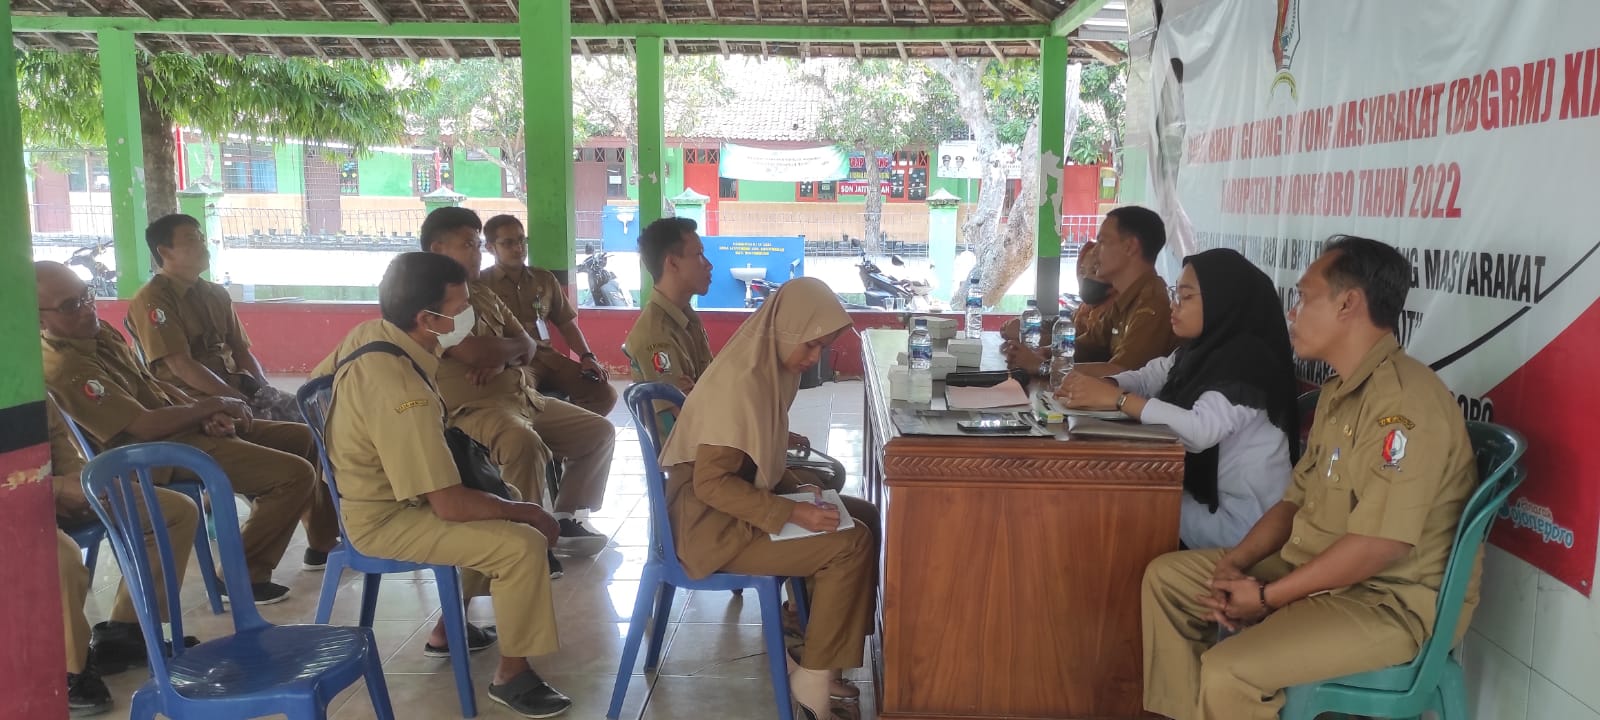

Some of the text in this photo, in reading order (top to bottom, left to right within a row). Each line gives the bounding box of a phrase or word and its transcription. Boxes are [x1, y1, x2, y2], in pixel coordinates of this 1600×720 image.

[1284, 104, 1334, 155] RYONG
[1332, 83, 1445, 150] MASYARAKAT
[1445, 58, 1556, 136] (BBGRM)
[840, 185, 854, 193] SDN
[1273, 169, 1356, 217] BJONEGORO
[1357, 166, 1409, 218] TAHUN
[1408, 161, 1462, 219] 2022
[1424, 248, 1546, 304] MASYARAKAT
